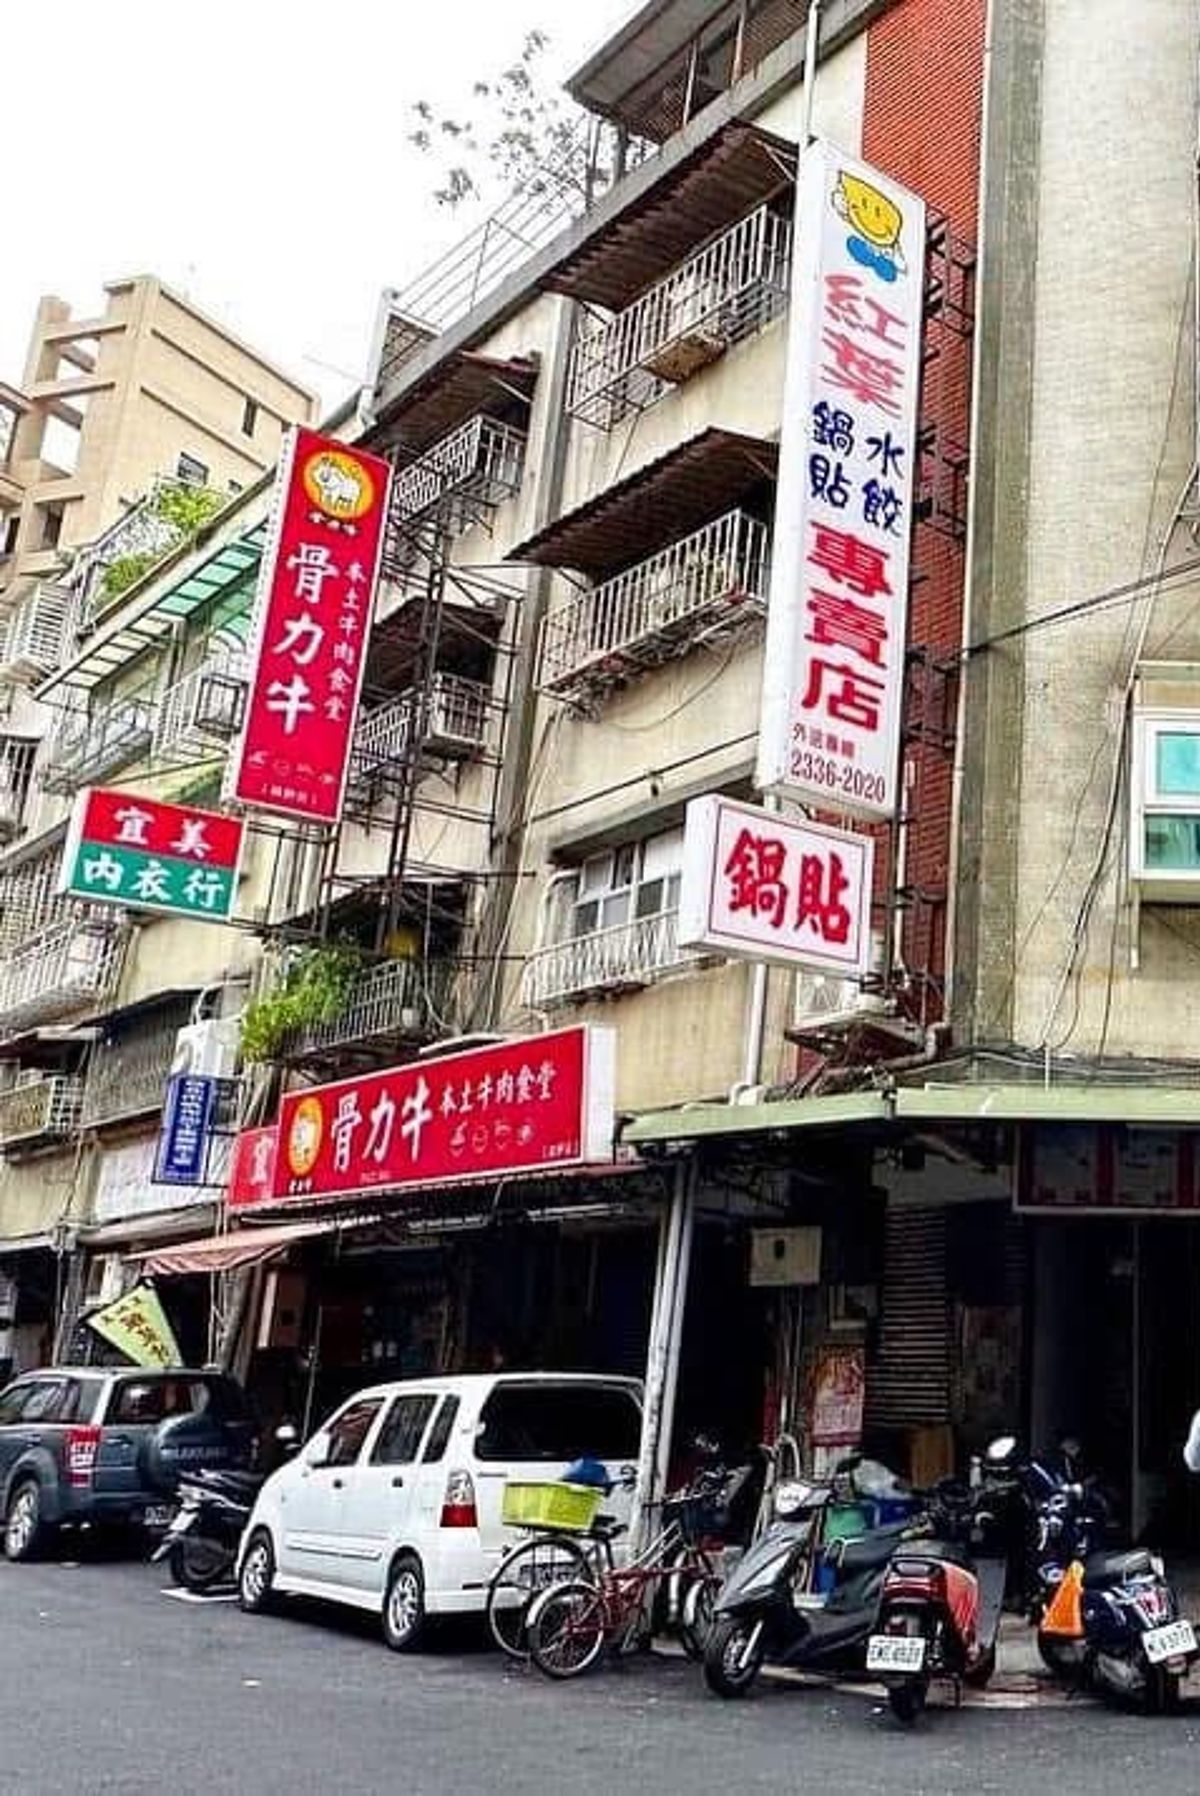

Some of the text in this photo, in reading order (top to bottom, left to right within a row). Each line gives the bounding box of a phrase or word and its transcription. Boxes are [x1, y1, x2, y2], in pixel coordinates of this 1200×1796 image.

[822, 274, 907, 420] 紅葉
[807, 400, 854, 510] 鍋貼
[861, 430, 905, 538] 水餃
[266, 541, 340, 735] 骨力牛
[323, 560, 368, 723] 本土牛肉食堂
[801, 519, 894, 732] 專賣店
[791, 747, 886, 804] 2336-2020
[82, 851, 225, 908] 內衣行
[113, 805, 213, 859] 宜美
[723, 828, 852, 946] 鍋貼
[330, 1074, 434, 1174] 骨力牛
[439, 1060, 556, 1118] 本土牛肉食堂
